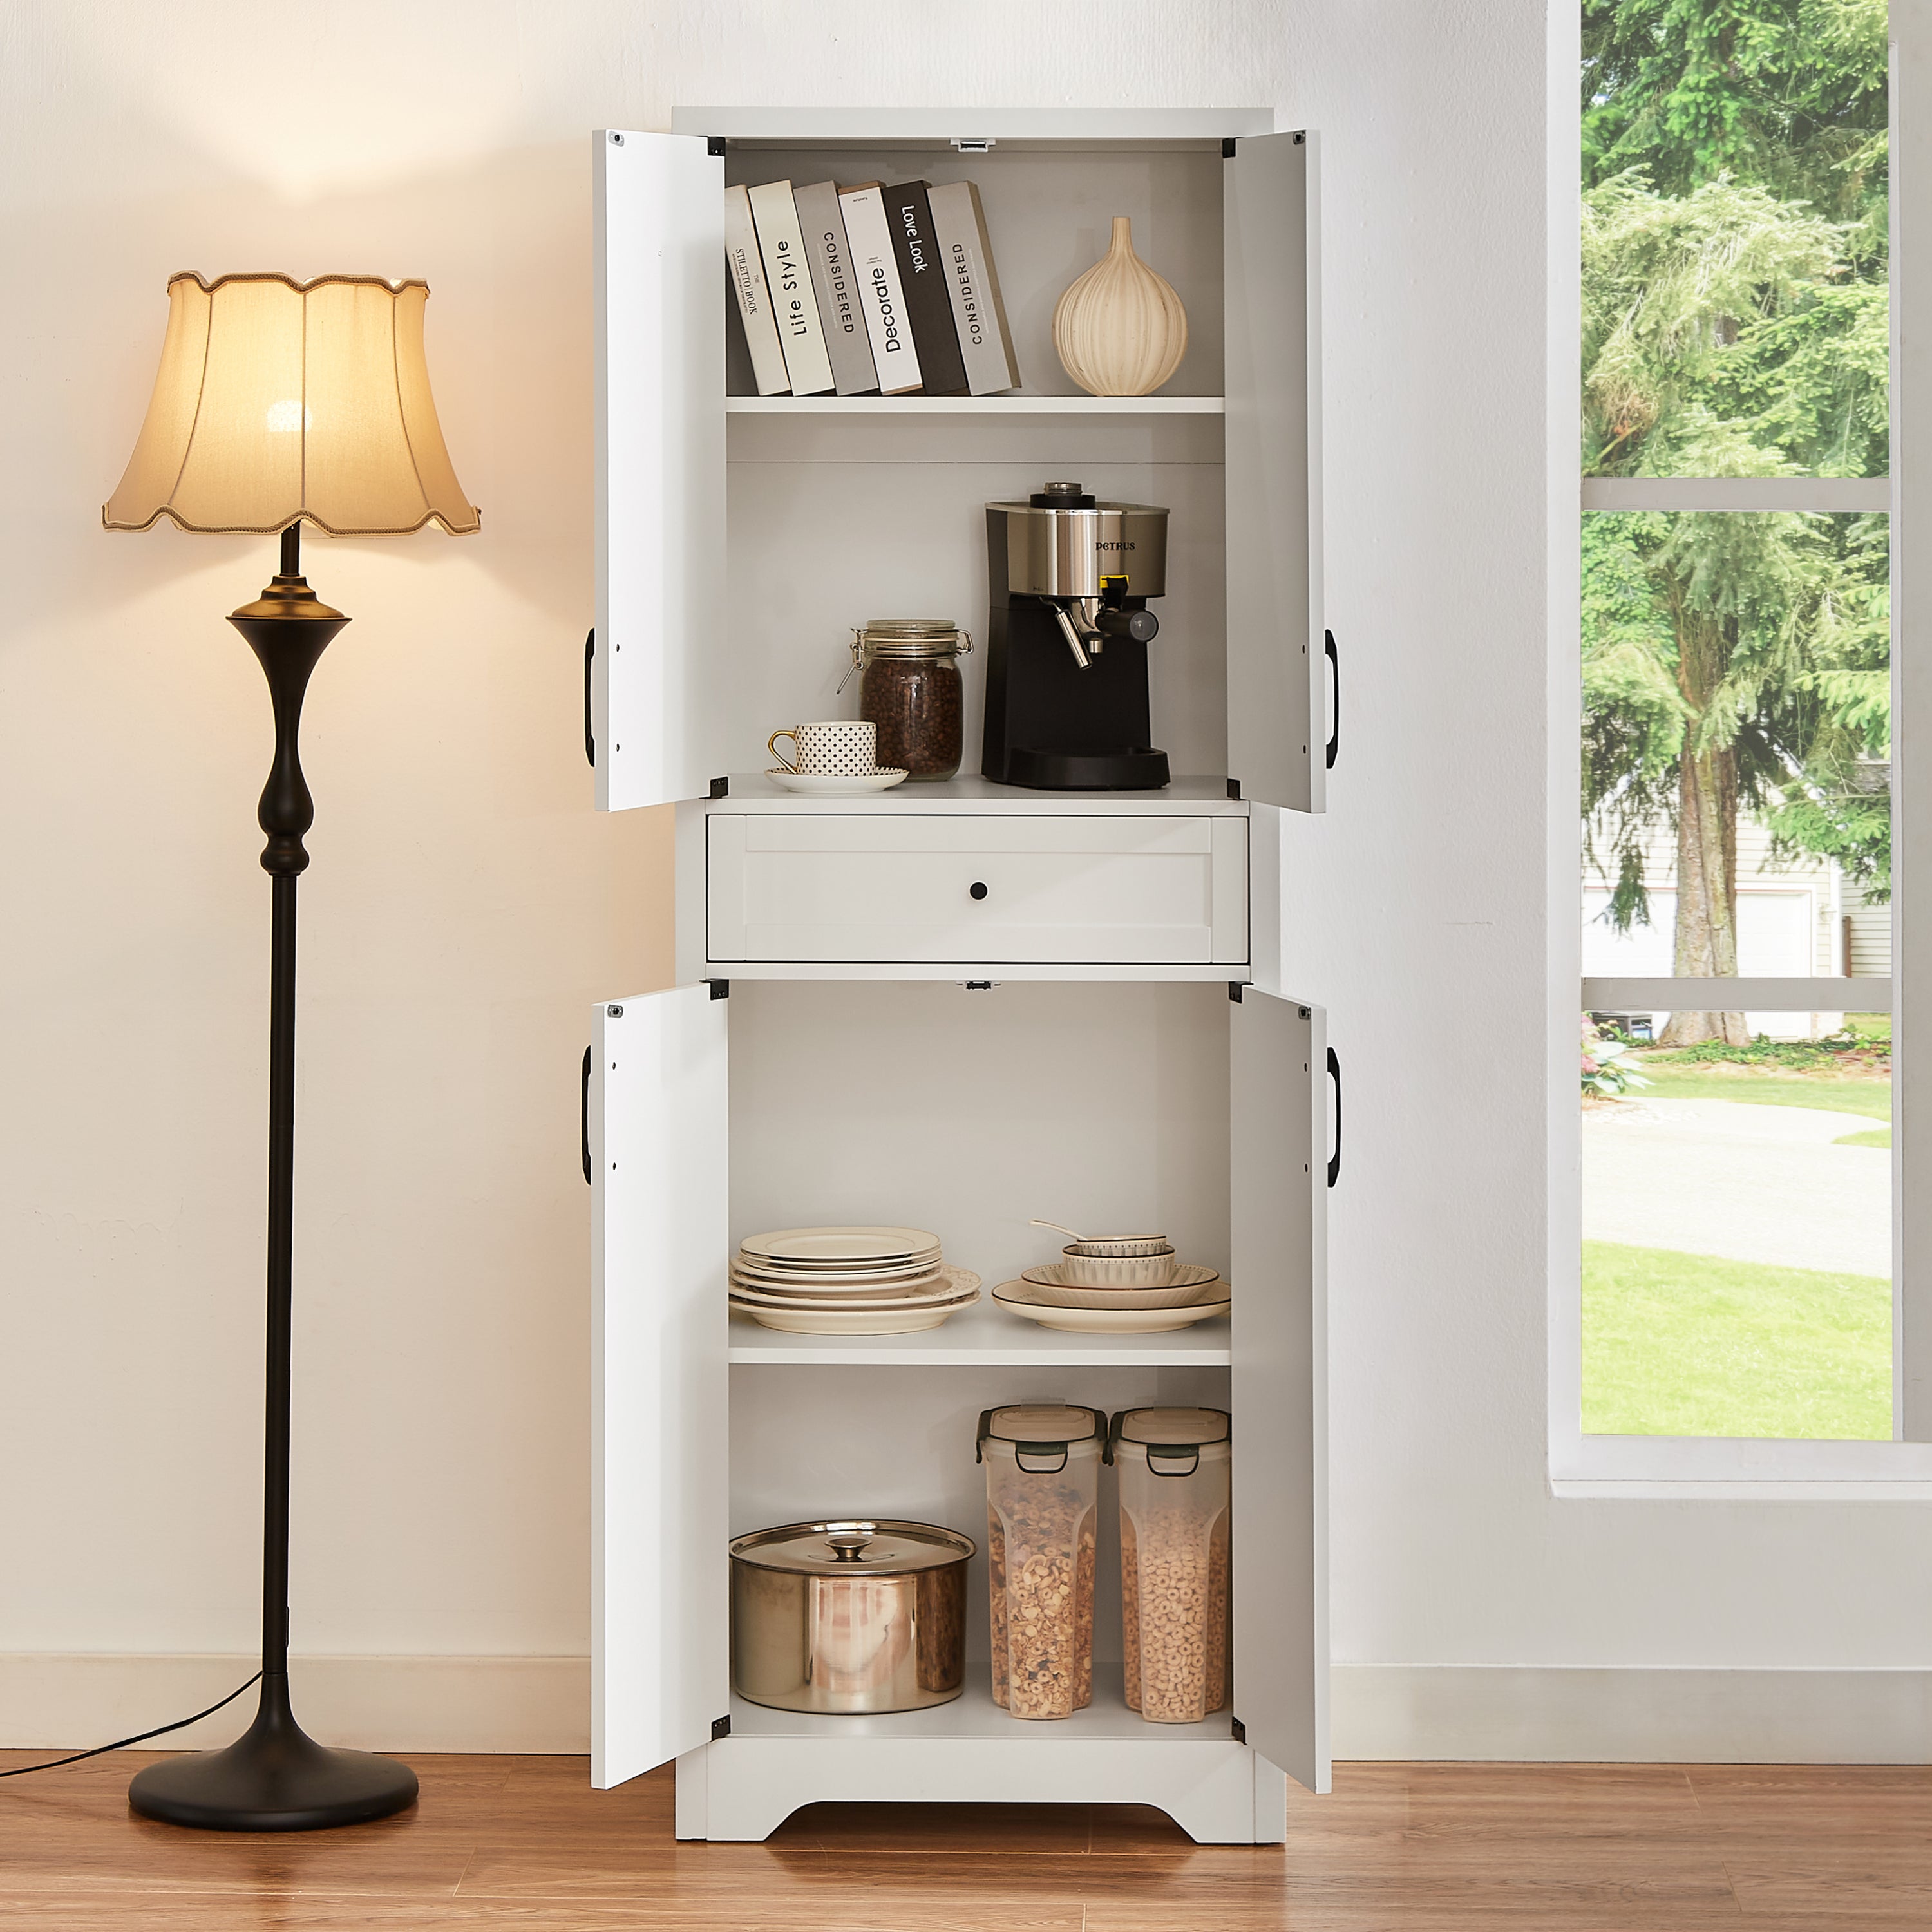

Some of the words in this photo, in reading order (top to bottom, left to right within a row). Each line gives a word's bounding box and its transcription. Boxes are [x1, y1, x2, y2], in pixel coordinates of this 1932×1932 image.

[902, 205, 918, 237] Love
[777, 241, 797, 290] Style
[909, 240, 928, 273] Look
[824, 231, 854, 333] CONSIDERED
[952, 243, 982, 345] CONSIDERED
[789, 300, 807, 336] Life
[871, 267, 901, 353] Decorate
[1095, 542, 1135, 551] PETRUS
